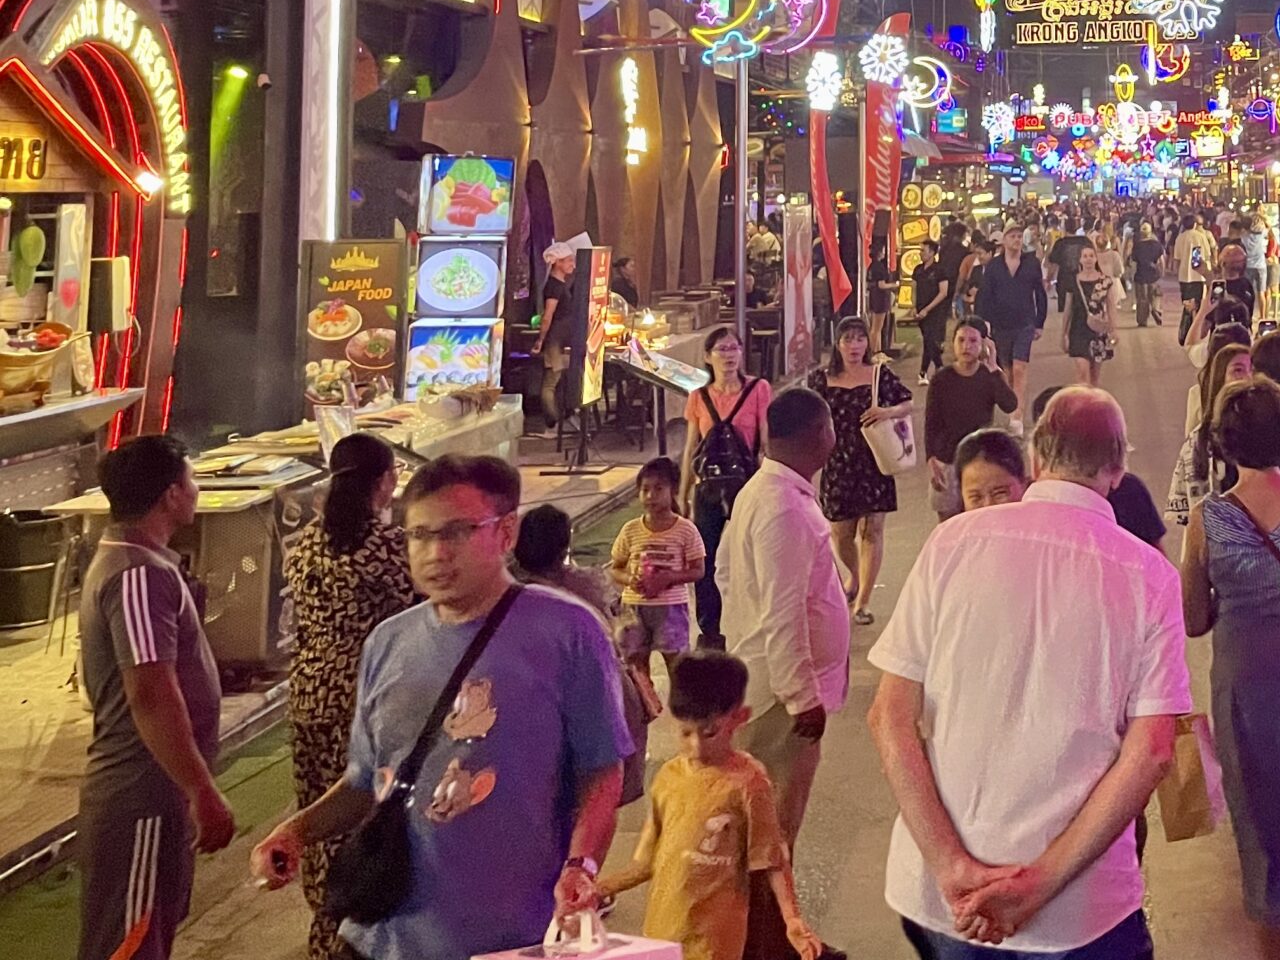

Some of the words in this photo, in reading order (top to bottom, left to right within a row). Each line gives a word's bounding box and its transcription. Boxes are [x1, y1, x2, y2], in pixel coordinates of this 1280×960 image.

[1016, 21, 1079, 45] KRONG
[131, 25, 192, 215] RESTAURANT
[1054, 112, 1094, 128] PUB
[1178, 110, 1223, 125] Angko
[327, 278, 373, 292] JAPAN
[357, 287, 393, 301] FOOD
